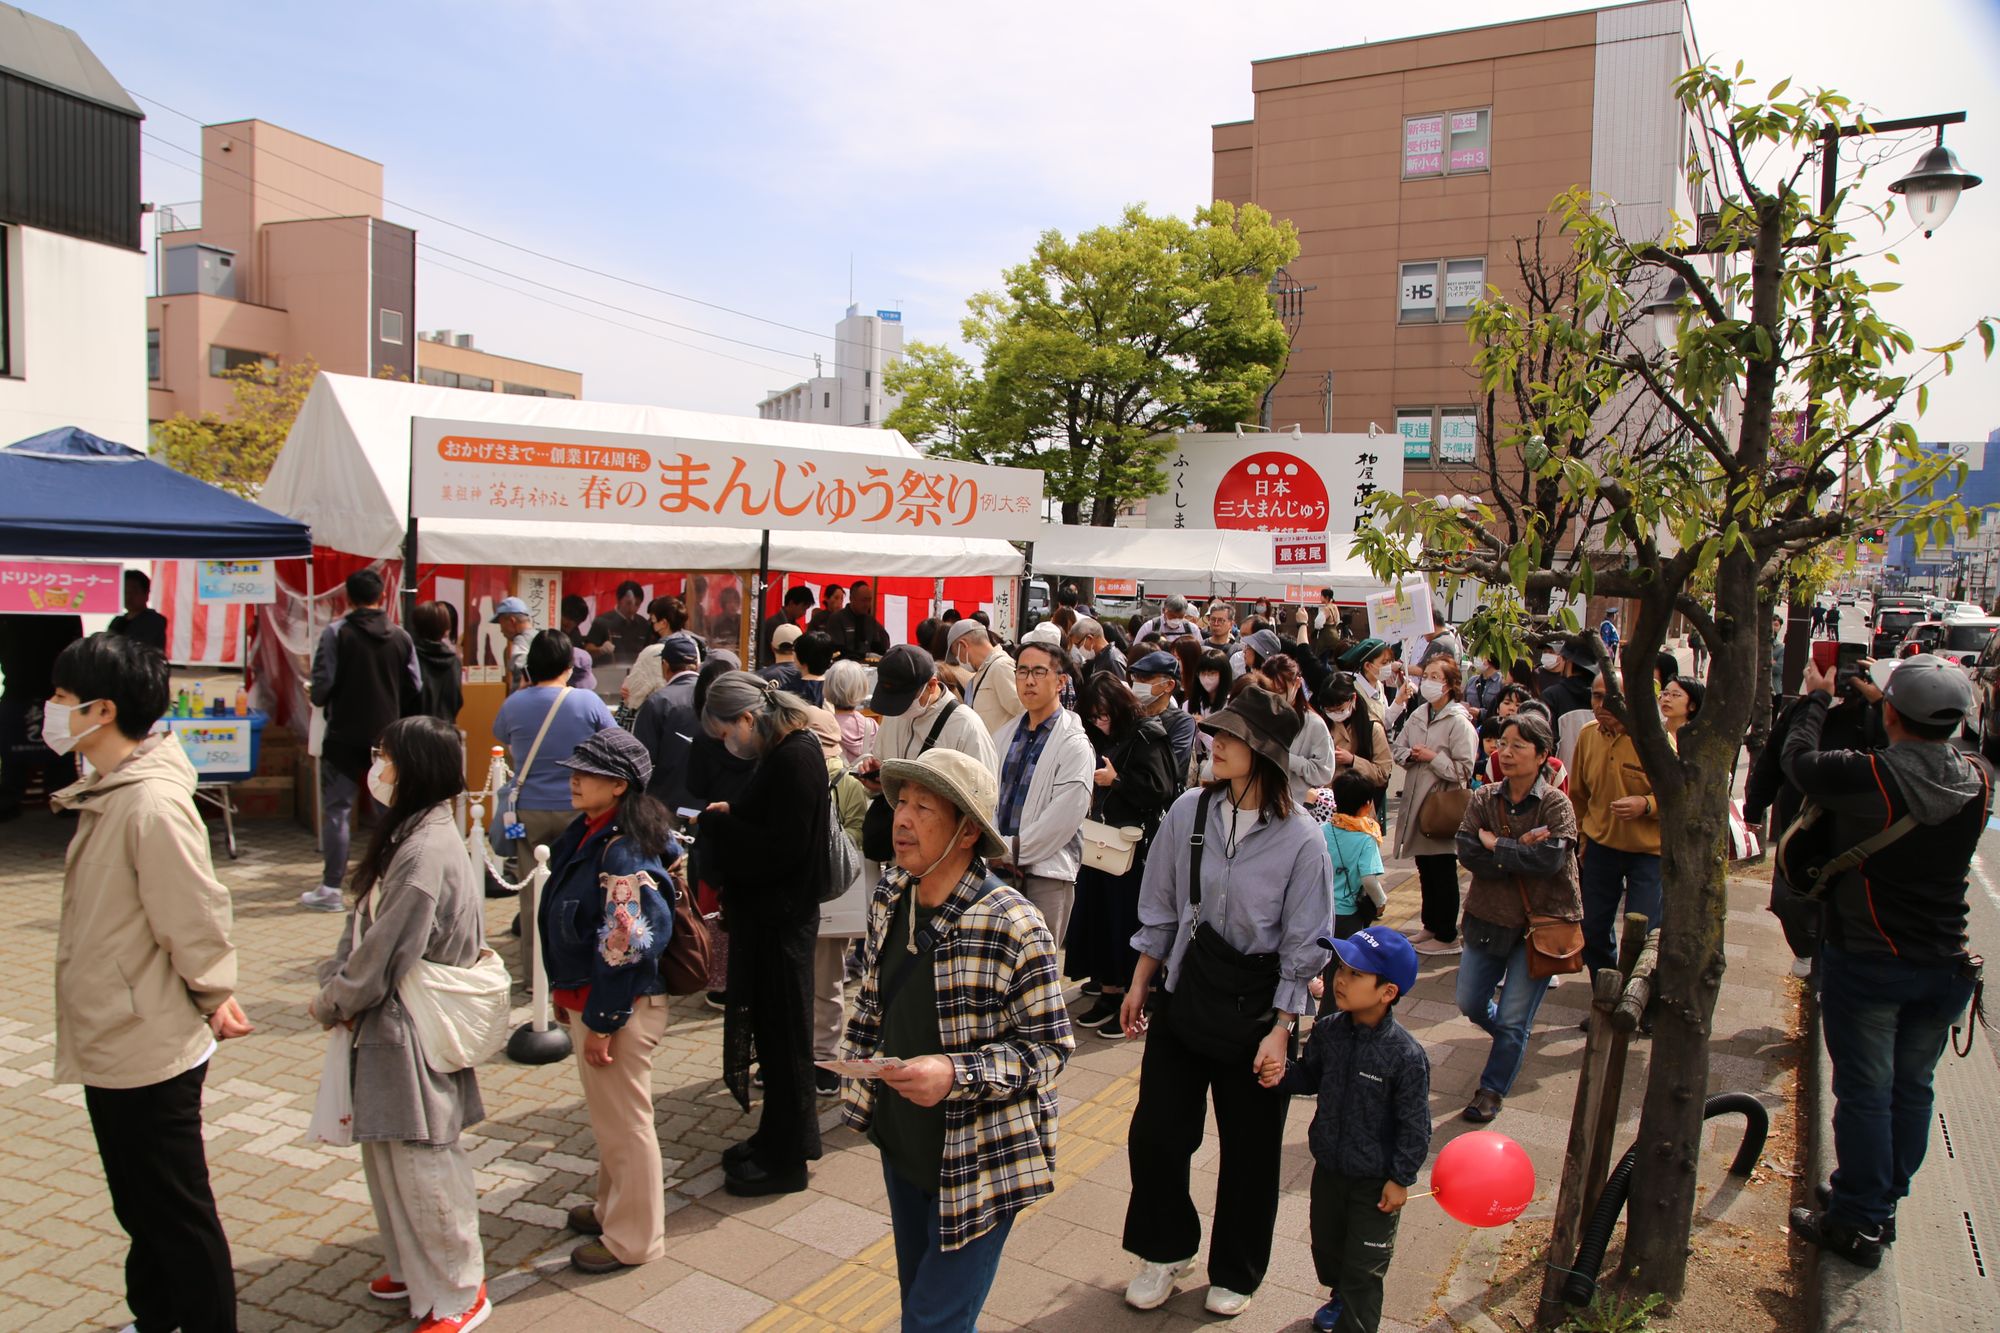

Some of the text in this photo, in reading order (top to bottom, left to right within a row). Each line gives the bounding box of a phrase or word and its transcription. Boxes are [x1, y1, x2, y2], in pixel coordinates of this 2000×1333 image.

[1407, 122, 1441, 135] 新年度
[1407, 138, 1441, 152] 受付中
[1400, 422, 1430, 439] 東進
[1173, 454, 1190, 530] ふくしま
[1255, 480, 1291, 497] 日本
[979, 491, 1032, 514] 例大祭
[1217, 499, 1326, 519] 三大まんじゅう
[1280, 546, 1322, 561] 最後尾
[1, 571, 114, 586] ドリンクコーナー
[528, 577, 544, 630] 薄皮ソフト
